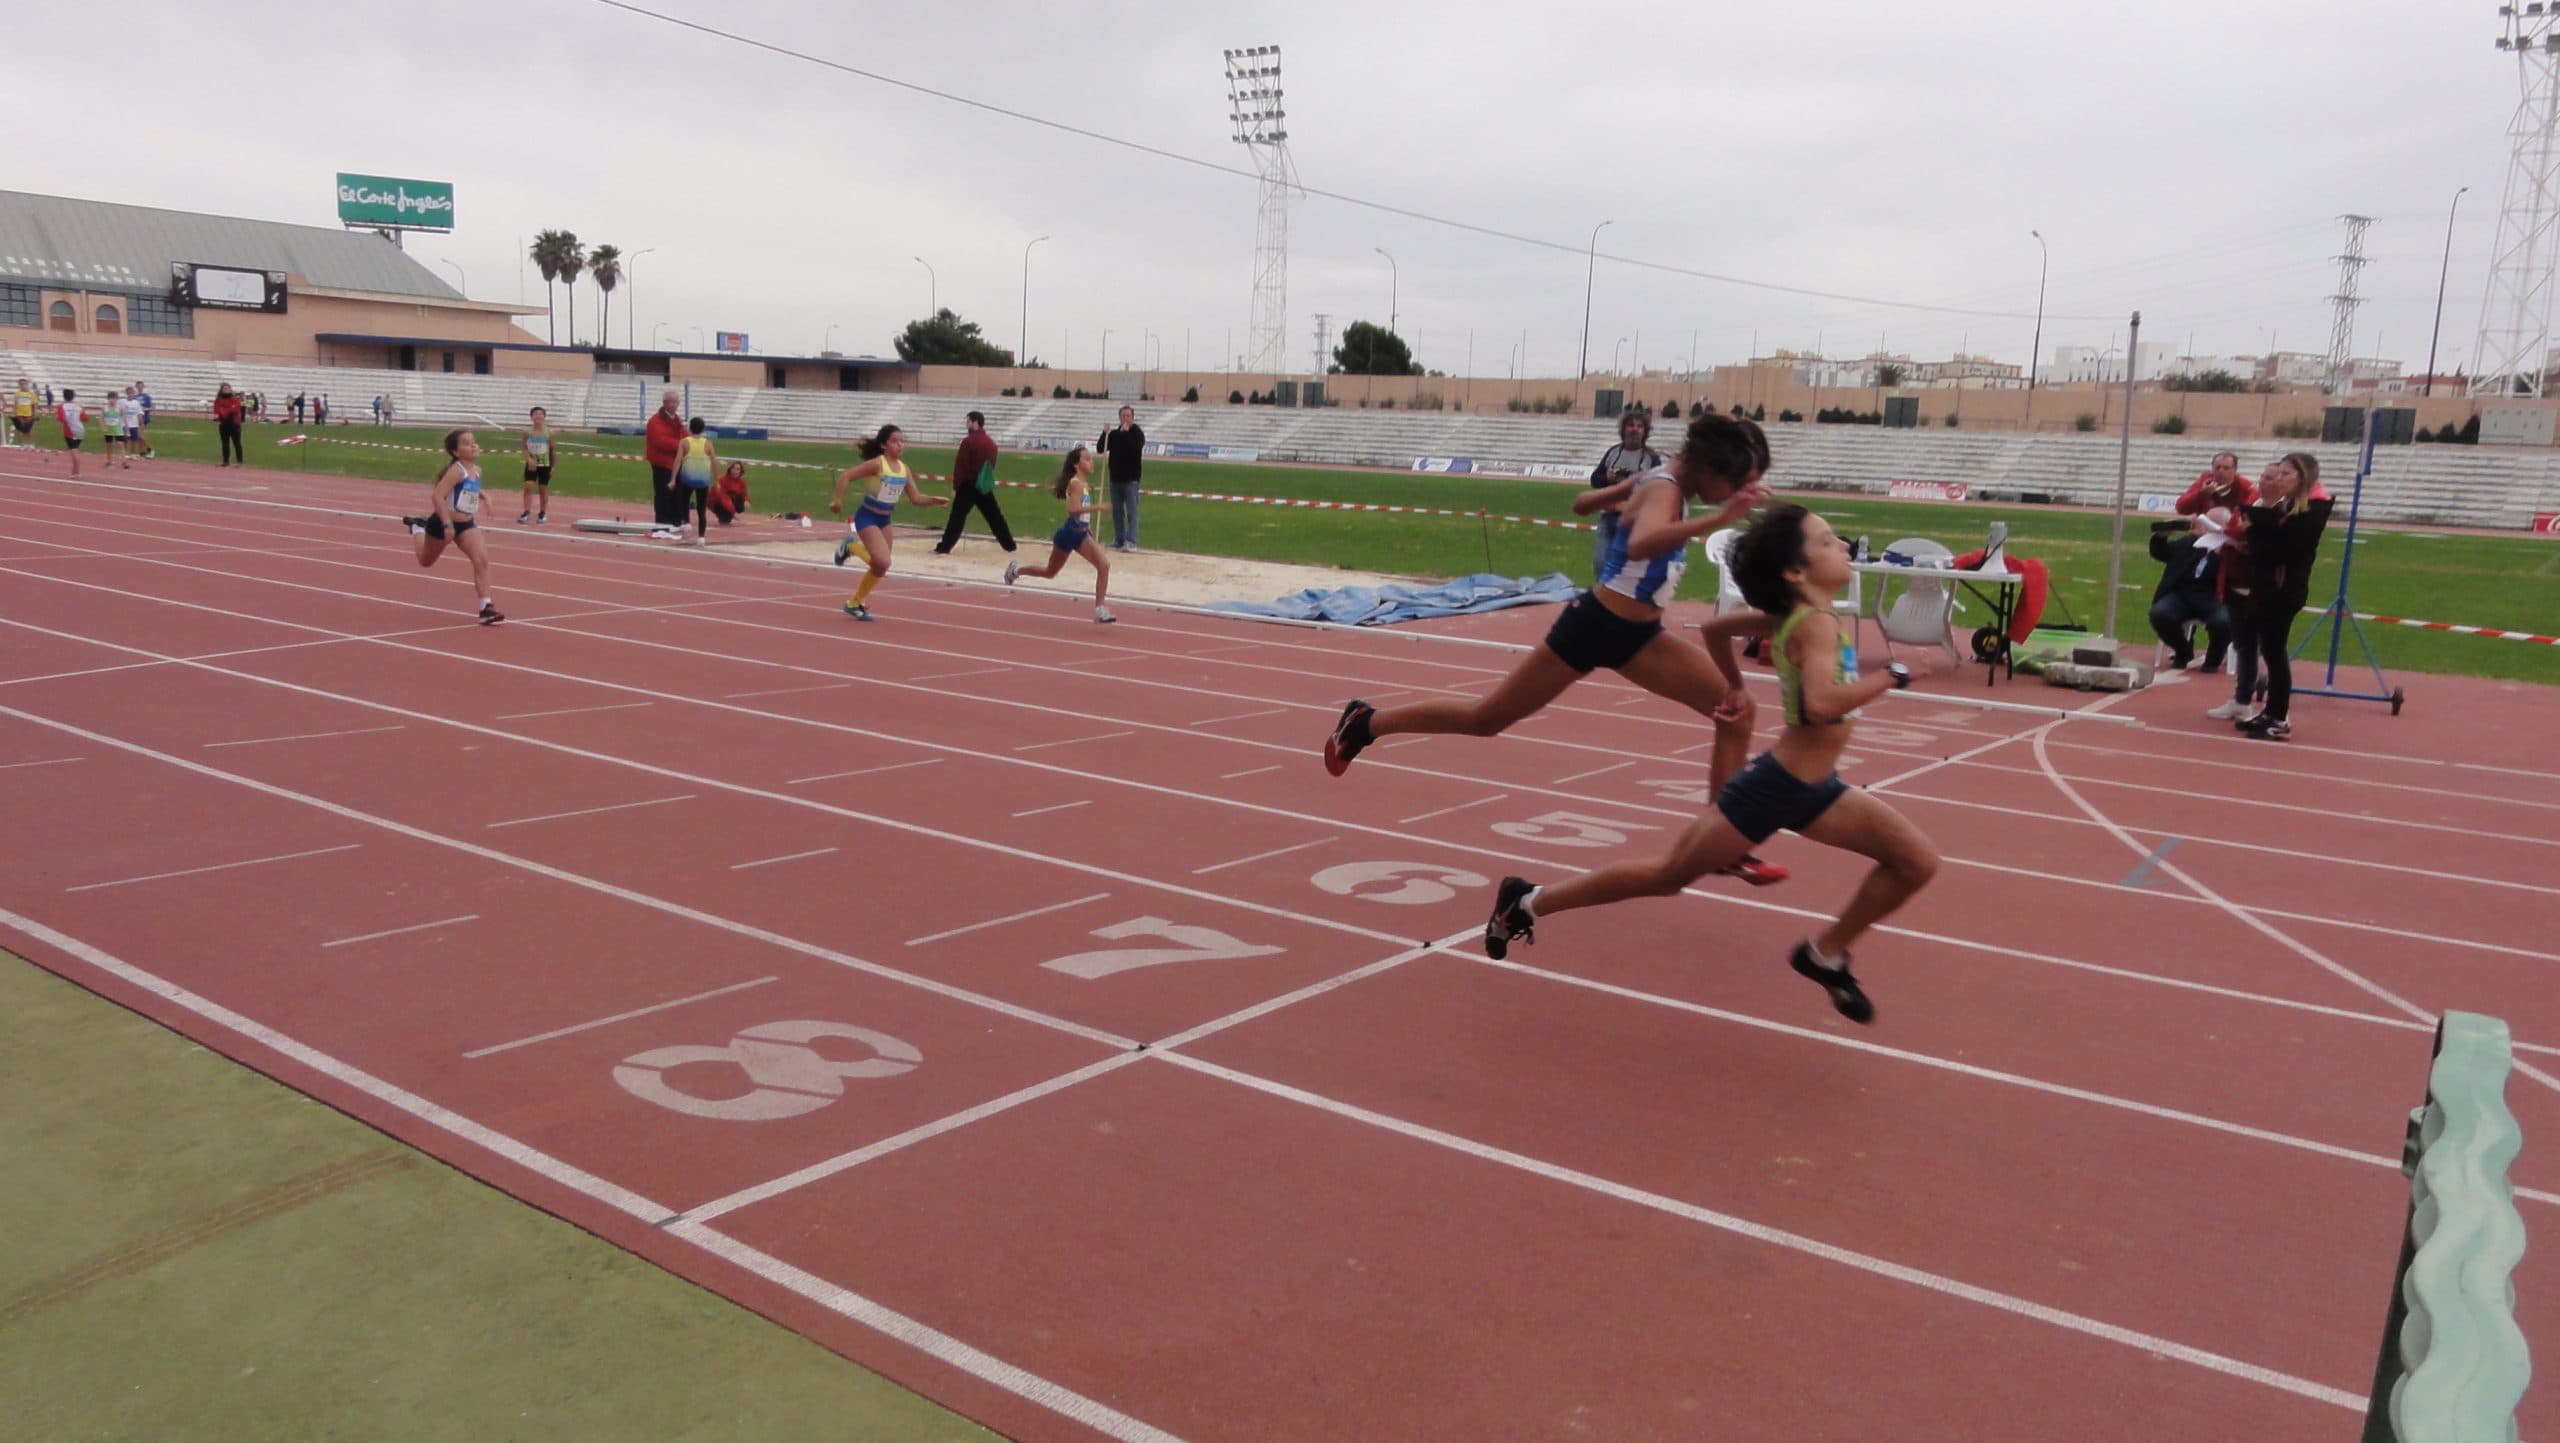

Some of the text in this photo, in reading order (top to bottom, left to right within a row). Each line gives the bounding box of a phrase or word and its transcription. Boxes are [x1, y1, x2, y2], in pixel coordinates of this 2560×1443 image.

[339, 185, 452, 213] El Corte Inglés
[1491, 810, 1664, 848] 5
[1310, 860, 1490, 905] 6
[1039, 915, 1288, 980] 7
[611, 1020, 924, 1121] 8
